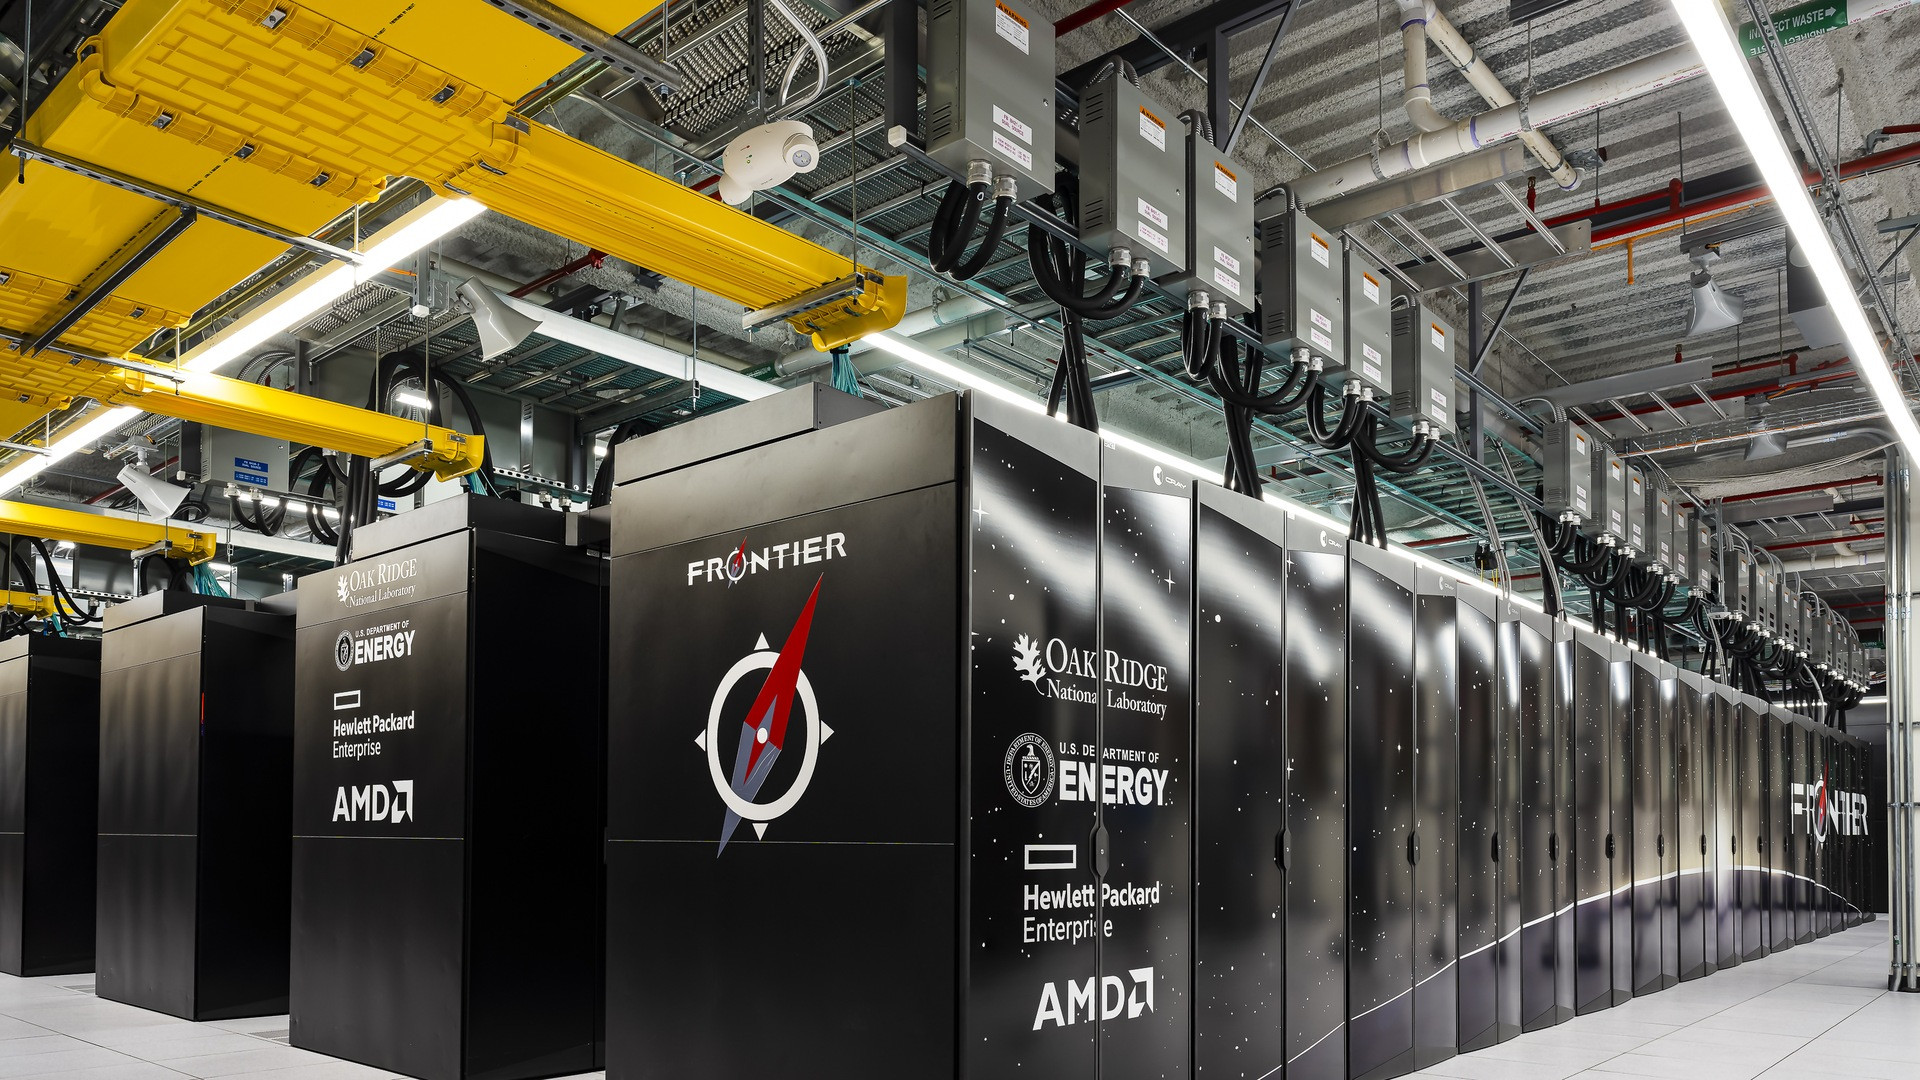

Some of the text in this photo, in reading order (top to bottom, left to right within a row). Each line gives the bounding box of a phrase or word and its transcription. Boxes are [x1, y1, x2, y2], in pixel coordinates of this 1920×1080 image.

[1749, 9, 1824, 40] INECT WASTE
[350, 558, 417, 592] OAK RIDGE
[687, 532, 847, 586] FRONTIER
[350, 584, 416, 608] National Laboratory
[355, 619, 410, 638] U.S. DEPARTMENT OF
[355, 629, 416, 665] ENERGY
[1046, 638, 1169, 692] OAK RIDGE
[1047, 678, 1168, 721] Nationa Laboratory
[334, 710, 415, 737] Hewlett Packard
[333, 738, 381, 761] Enterprise
[1059, 741, 1160, 764] U.S. DEARTMENT OF
[1059, 760, 1169, 806] ENERGY
[332, 783, 390, 822] AMD
[1024, 880, 1160, 911] Hewlett Packard
[1032, 974, 1126, 1031] AMD
